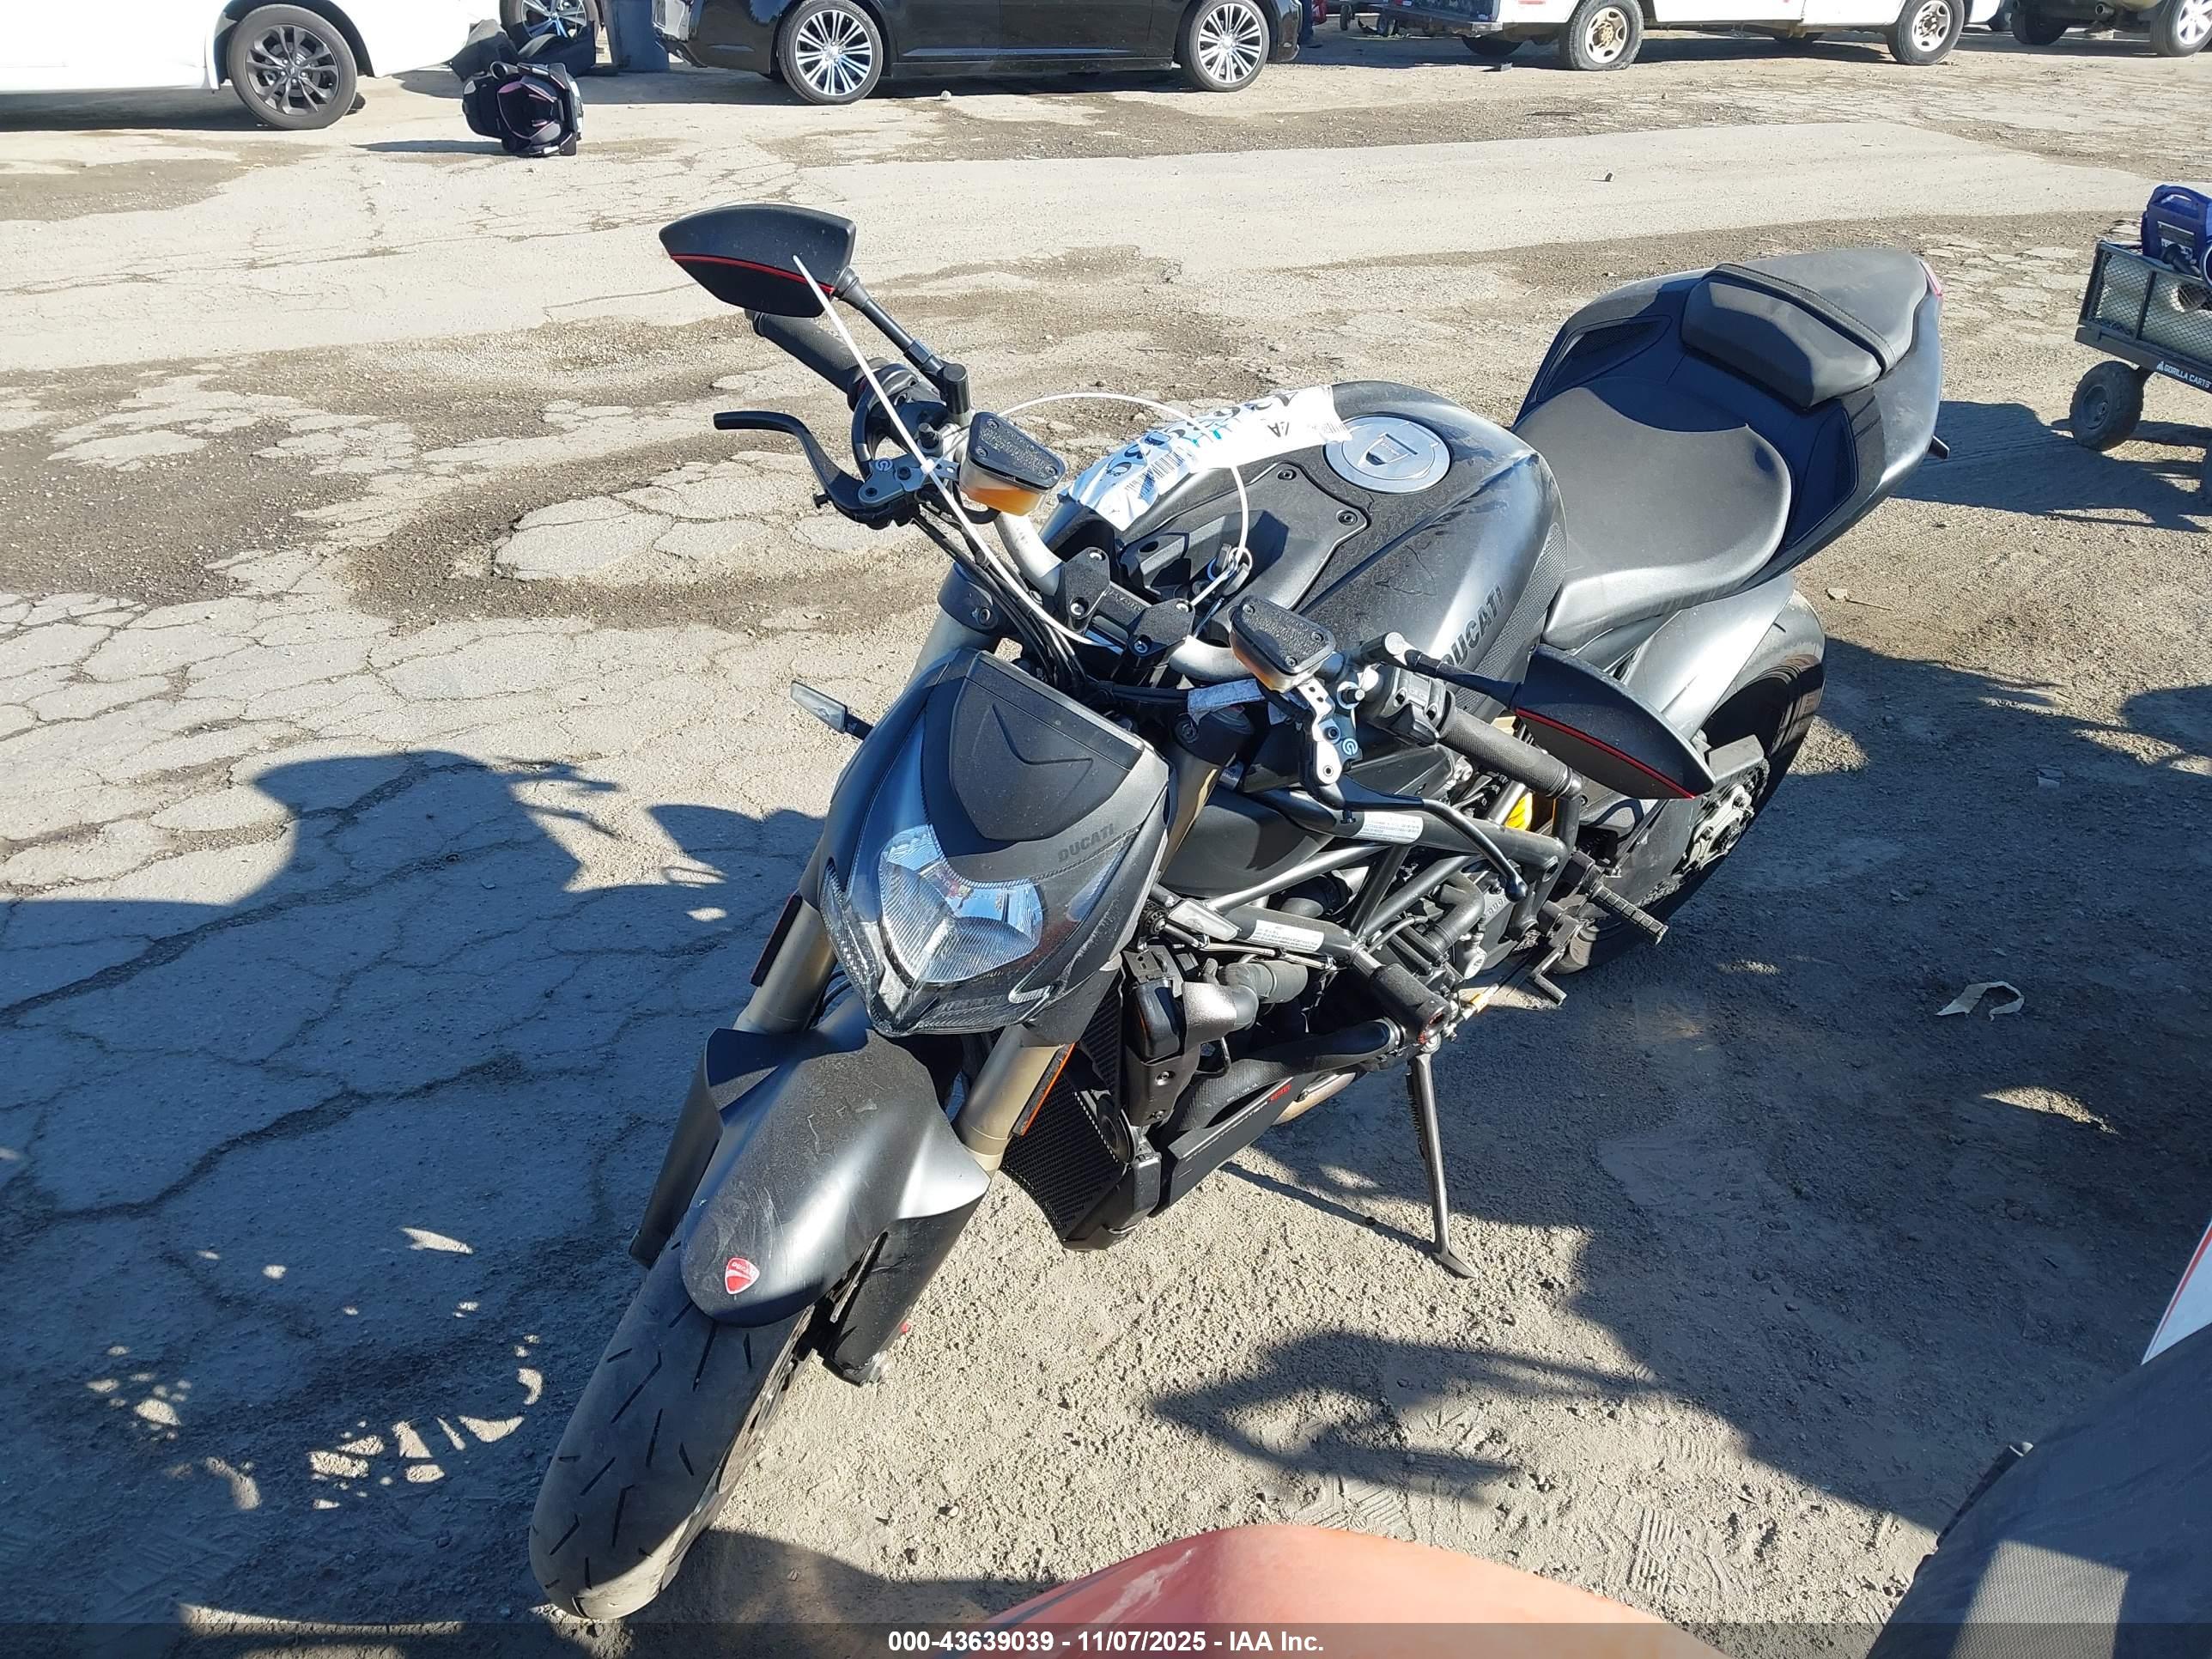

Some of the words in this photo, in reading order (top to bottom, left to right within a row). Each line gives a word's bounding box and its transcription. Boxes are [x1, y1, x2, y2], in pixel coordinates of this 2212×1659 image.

[2164, 364, 2189, 380] GORILLA
[2189, 374, 2210, 389] CARTS
[1057, 822, 1115, 863] DUCATI
